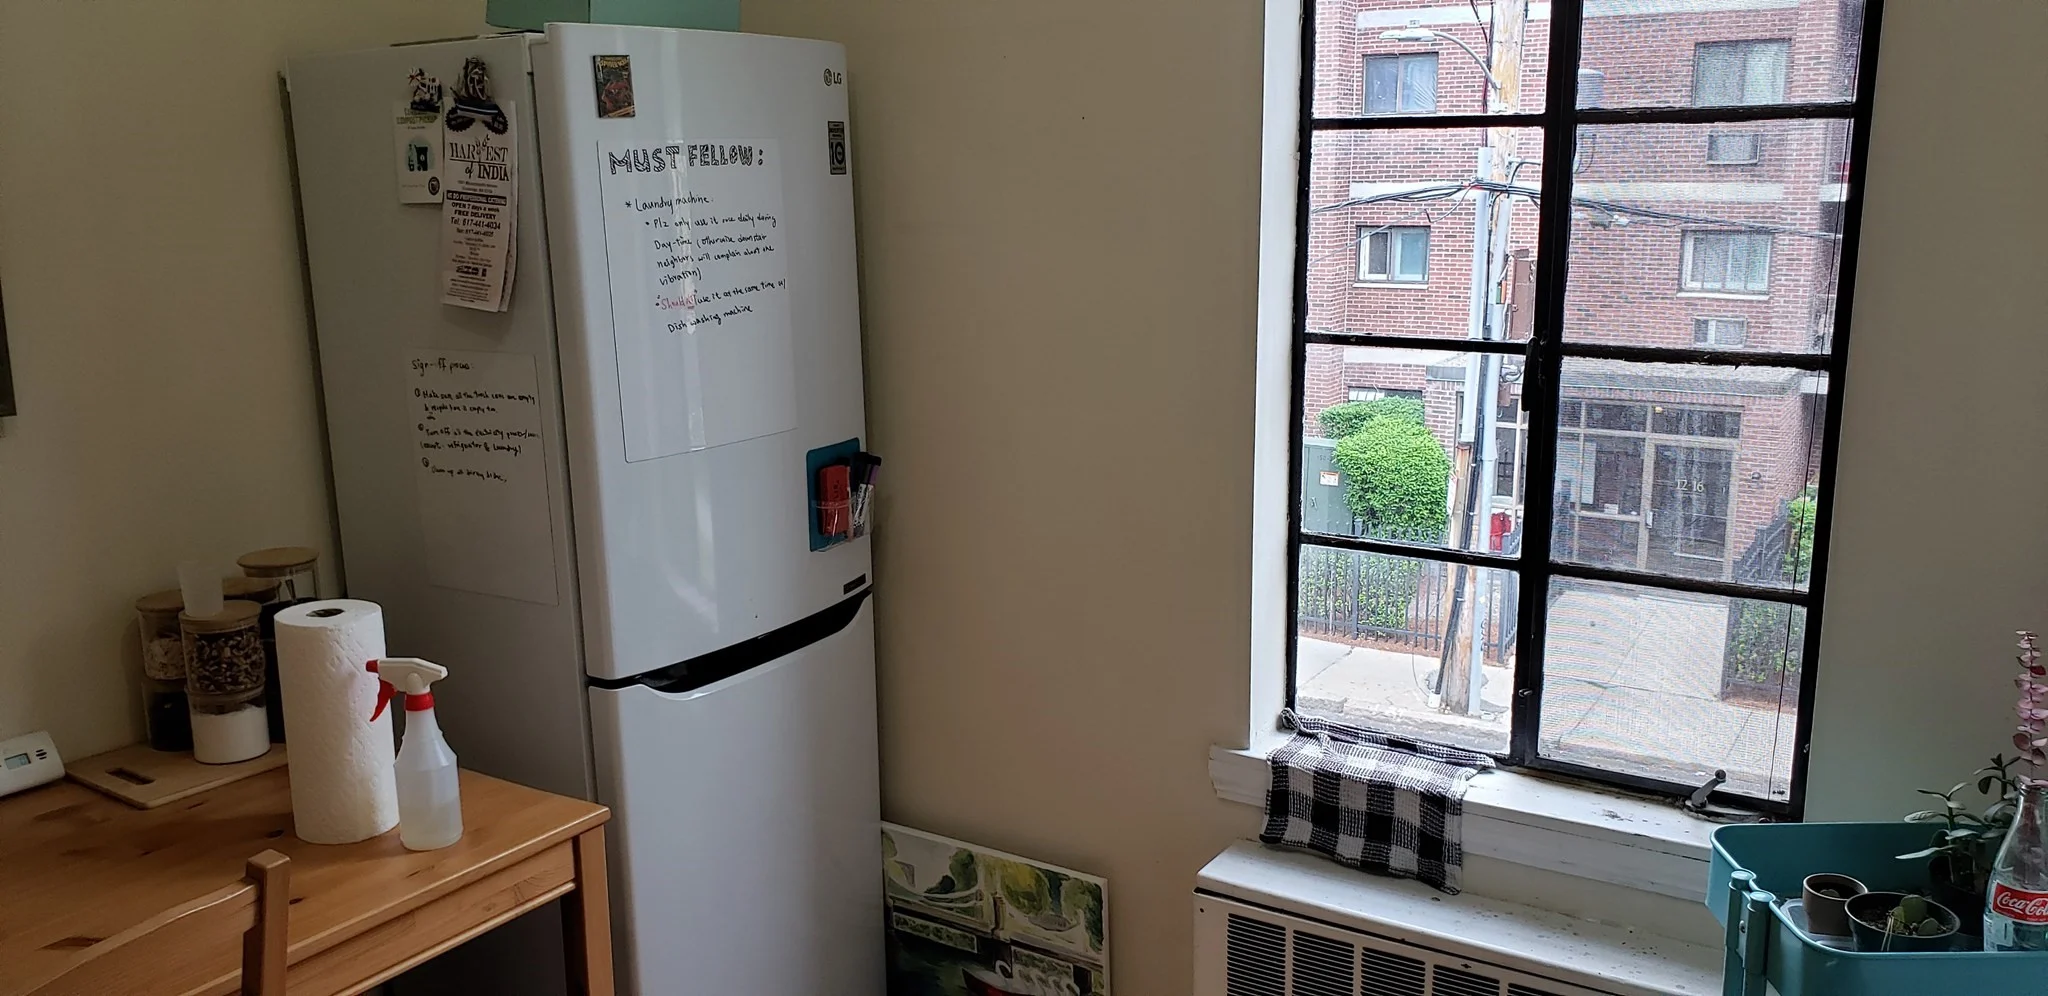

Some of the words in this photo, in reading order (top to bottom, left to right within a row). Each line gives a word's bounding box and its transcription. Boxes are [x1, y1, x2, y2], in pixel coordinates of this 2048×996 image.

[833, 72, 841, 84] LG
[609, 146, 679, 175] MUST
[465, 162, 474, 178] of
[478, 164, 509, 181] INDIA
[636, 197, 674, 214] Laundry
[471, 211, 496, 219] DELIVERY
[654, 219, 669, 228] Plz
[675, 220, 690, 230] only
[710, 217, 718, 225] it
[738, 213, 755, 227] daily
[463, 219, 500, 229] 617-441-4034
[655, 236, 692, 252] Day-time
[698, 254, 710, 262] will
[714, 250, 741, 261] complain
[660, 267, 701, 286] vibration)
[732, 287, 740, 296] the
[741, 285, 760, 294] same
[761, 282, 775, 290] time
[668, 320, 688, 333] Dish
[691, 313, 721, 326] washing
[724, 305, 753, 318] machine
[1676, 479, 1704, 492] 12-16
